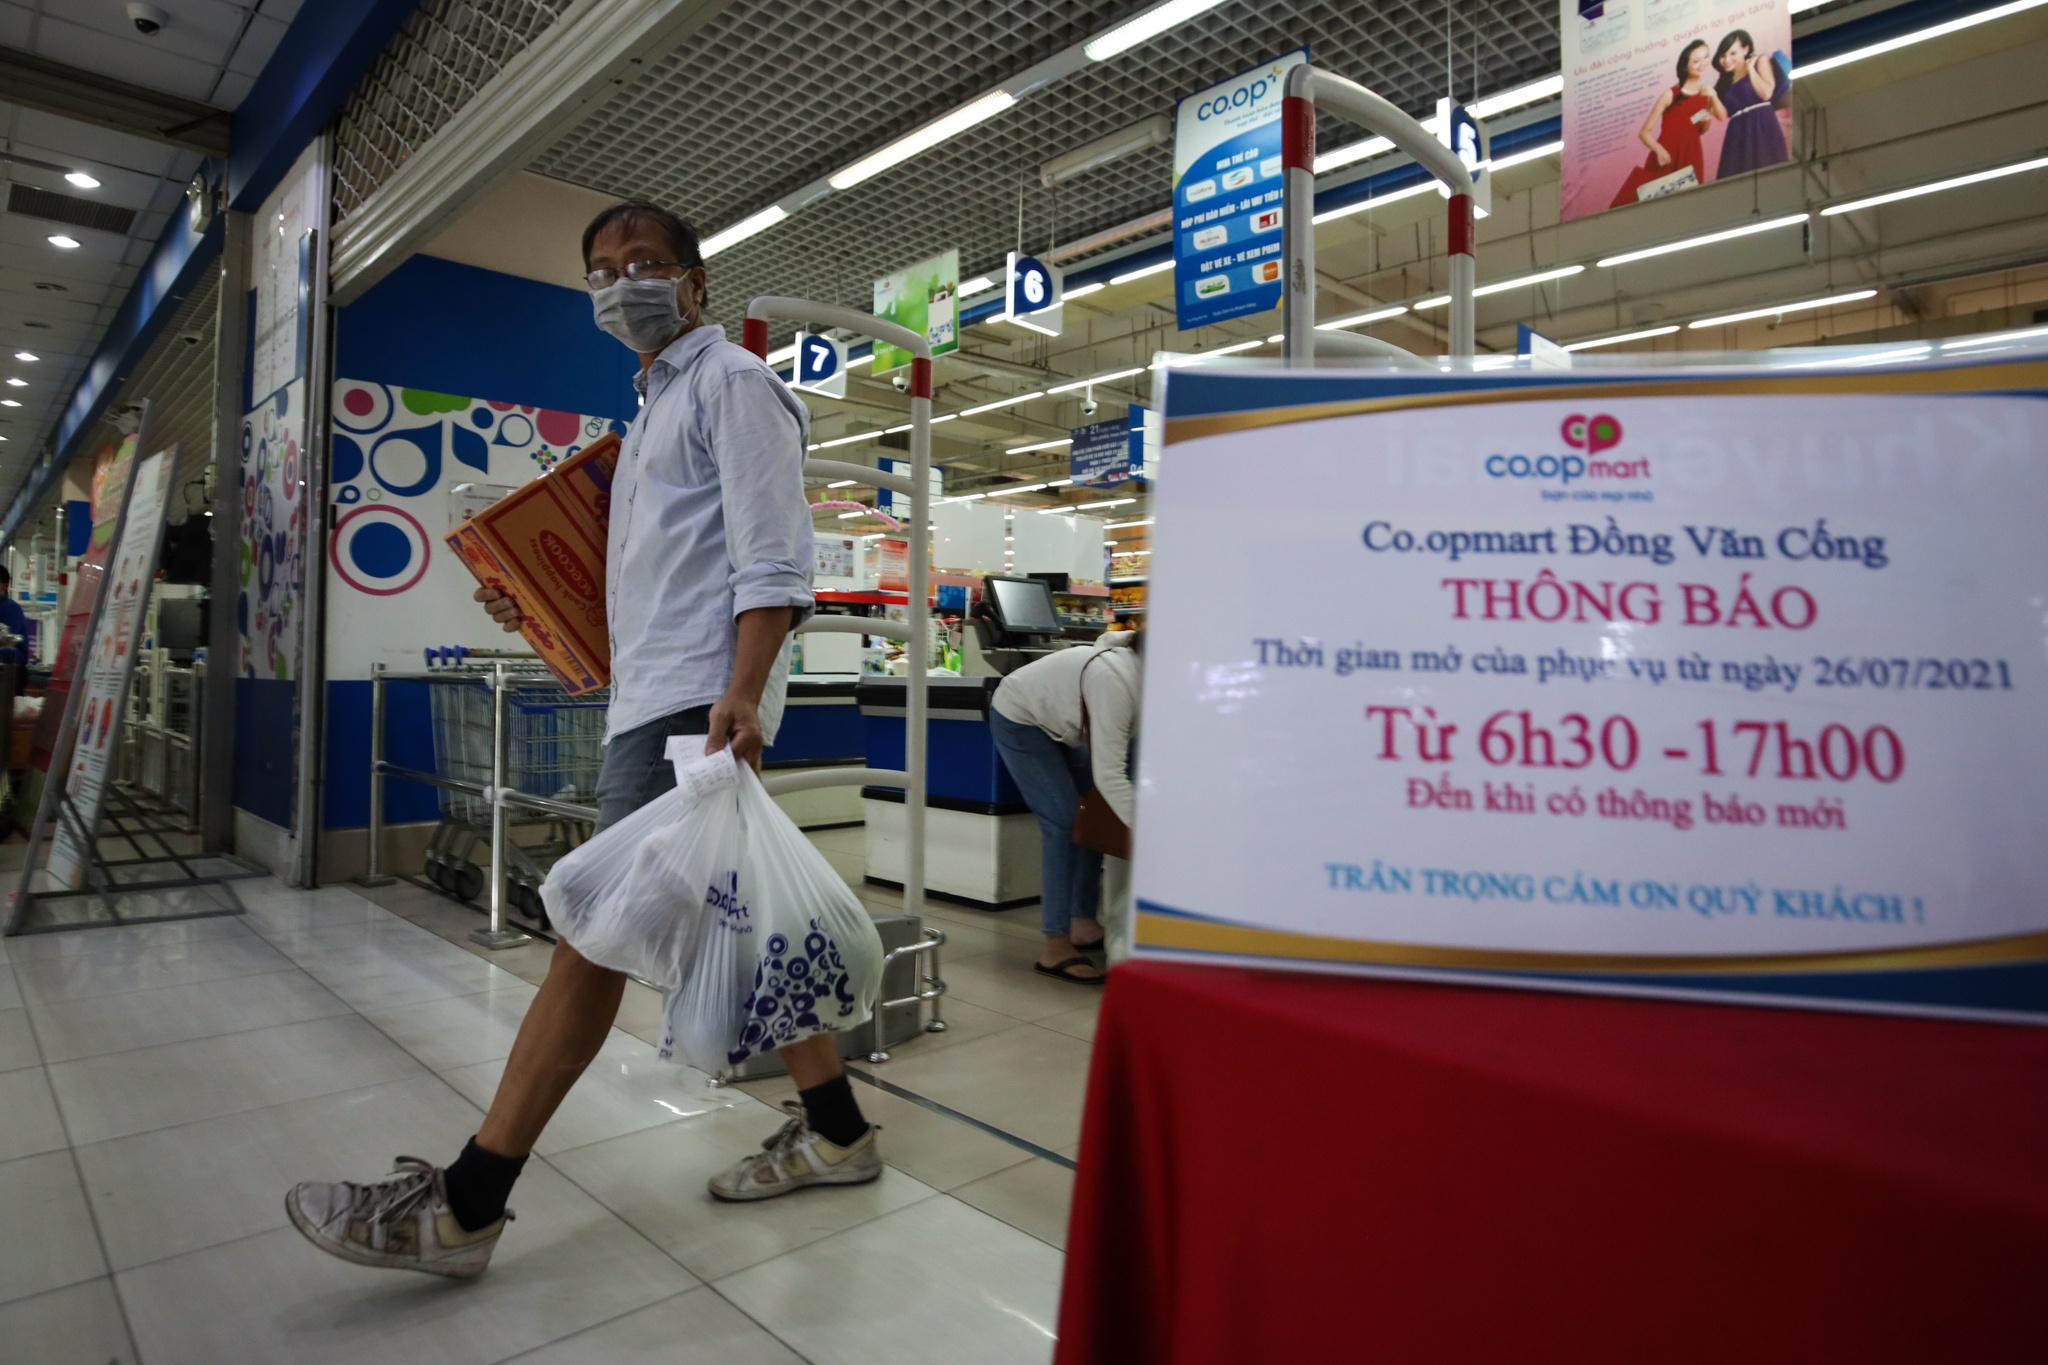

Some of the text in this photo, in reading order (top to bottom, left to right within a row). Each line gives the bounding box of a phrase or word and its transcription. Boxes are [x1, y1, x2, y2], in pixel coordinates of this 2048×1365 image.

[1607, 50, 1634, 65] cộng
[1673, 23, 1708, 43] quyền
[1728, 10, 1746, 26] gia
[1748, 0, 1776, 16] tăng
[1023, 269, 1045, 304] 6
[809, 343, 830, 372] 7
[1089, 424, 1099, 435] 21
[529, 537, 563, 592] happiness
[1362, 515, 1889, 570] Co.opmart Đồng Văn Cống
[1441, 567, 1818, 631] THÔNG BÁO
[1253, 637, 2014, 693] Thời gian mở của phục vụ từ ngày 26/07/2021
[1365, 704, 1458, 763] Từ
[1478, 709, 1640, 772] 6h30
[1406, 771, 1848, 831] Đến khi có thông báo mới
[1420, 867, 1536, 904] TRỌNG
[1629, 878, 1679, 910] ƠN
[1772, 884, 1906, 925] KHÁCH
